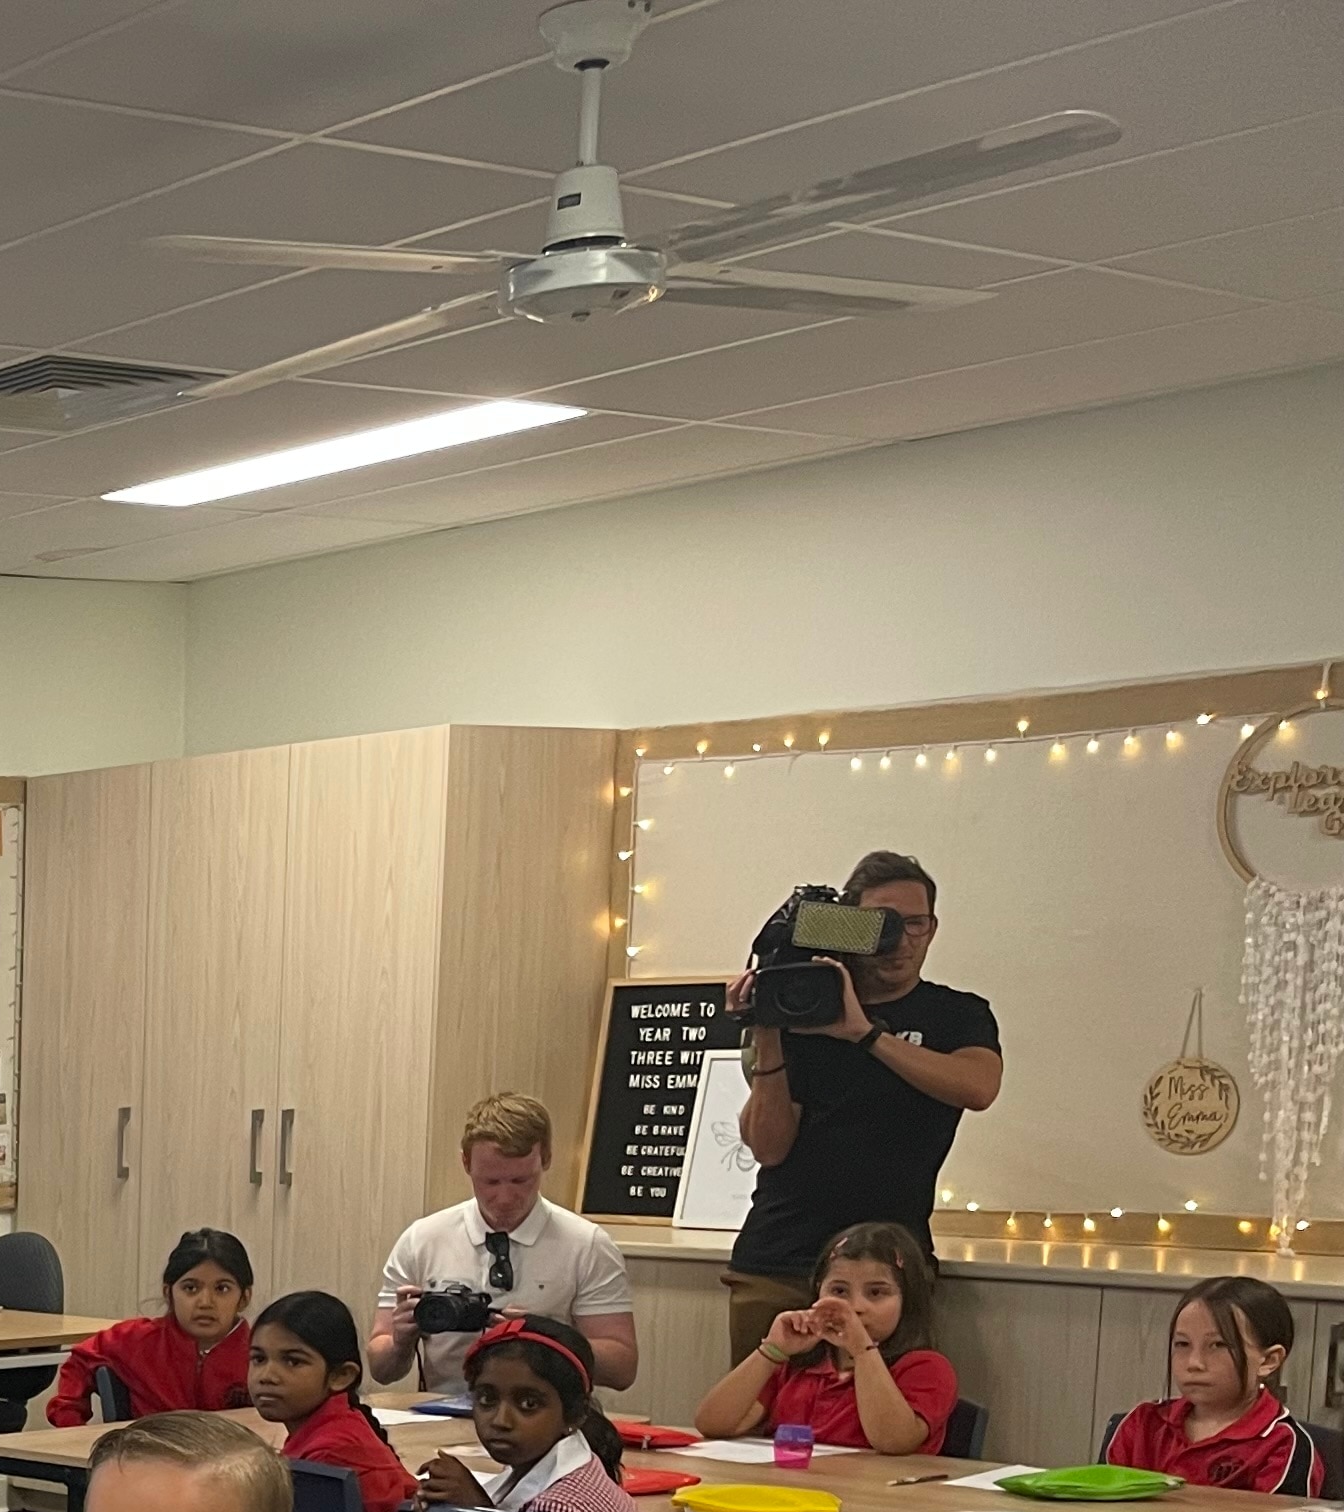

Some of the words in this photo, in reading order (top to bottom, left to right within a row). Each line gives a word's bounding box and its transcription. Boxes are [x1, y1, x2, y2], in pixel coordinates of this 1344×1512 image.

[630, 1002, 691, 1019] WELCOME
[699, 1002, 716, 1018] TO
[639, 1027, 671, 1042] YEAR
[681, 1026, 706, 1041] TWO
[630, 1051, 673, 1065] THREE
[680, 1050, 703, 1065] WIT
[628, 1074, 661, 1089] MISS
[667, 1074, 699, 1089] EMM
[1168, 1075, 1210, 1101] Miss
[643, 1104, 656, 1115] BE
[663, 1105, 685, 1115] KIND
[1167, 1102, 1223, 1130] Emma
[635, 1125, 648, 1136] BE
[653, 1125, 685, 1136] BRAVE
[626, 1145, 638, 1156] BE
[621, 1166, 634, 1176] BE
[629, 1186, 643, 1197] BE
[650, 1187, 667, 1198] YOU
